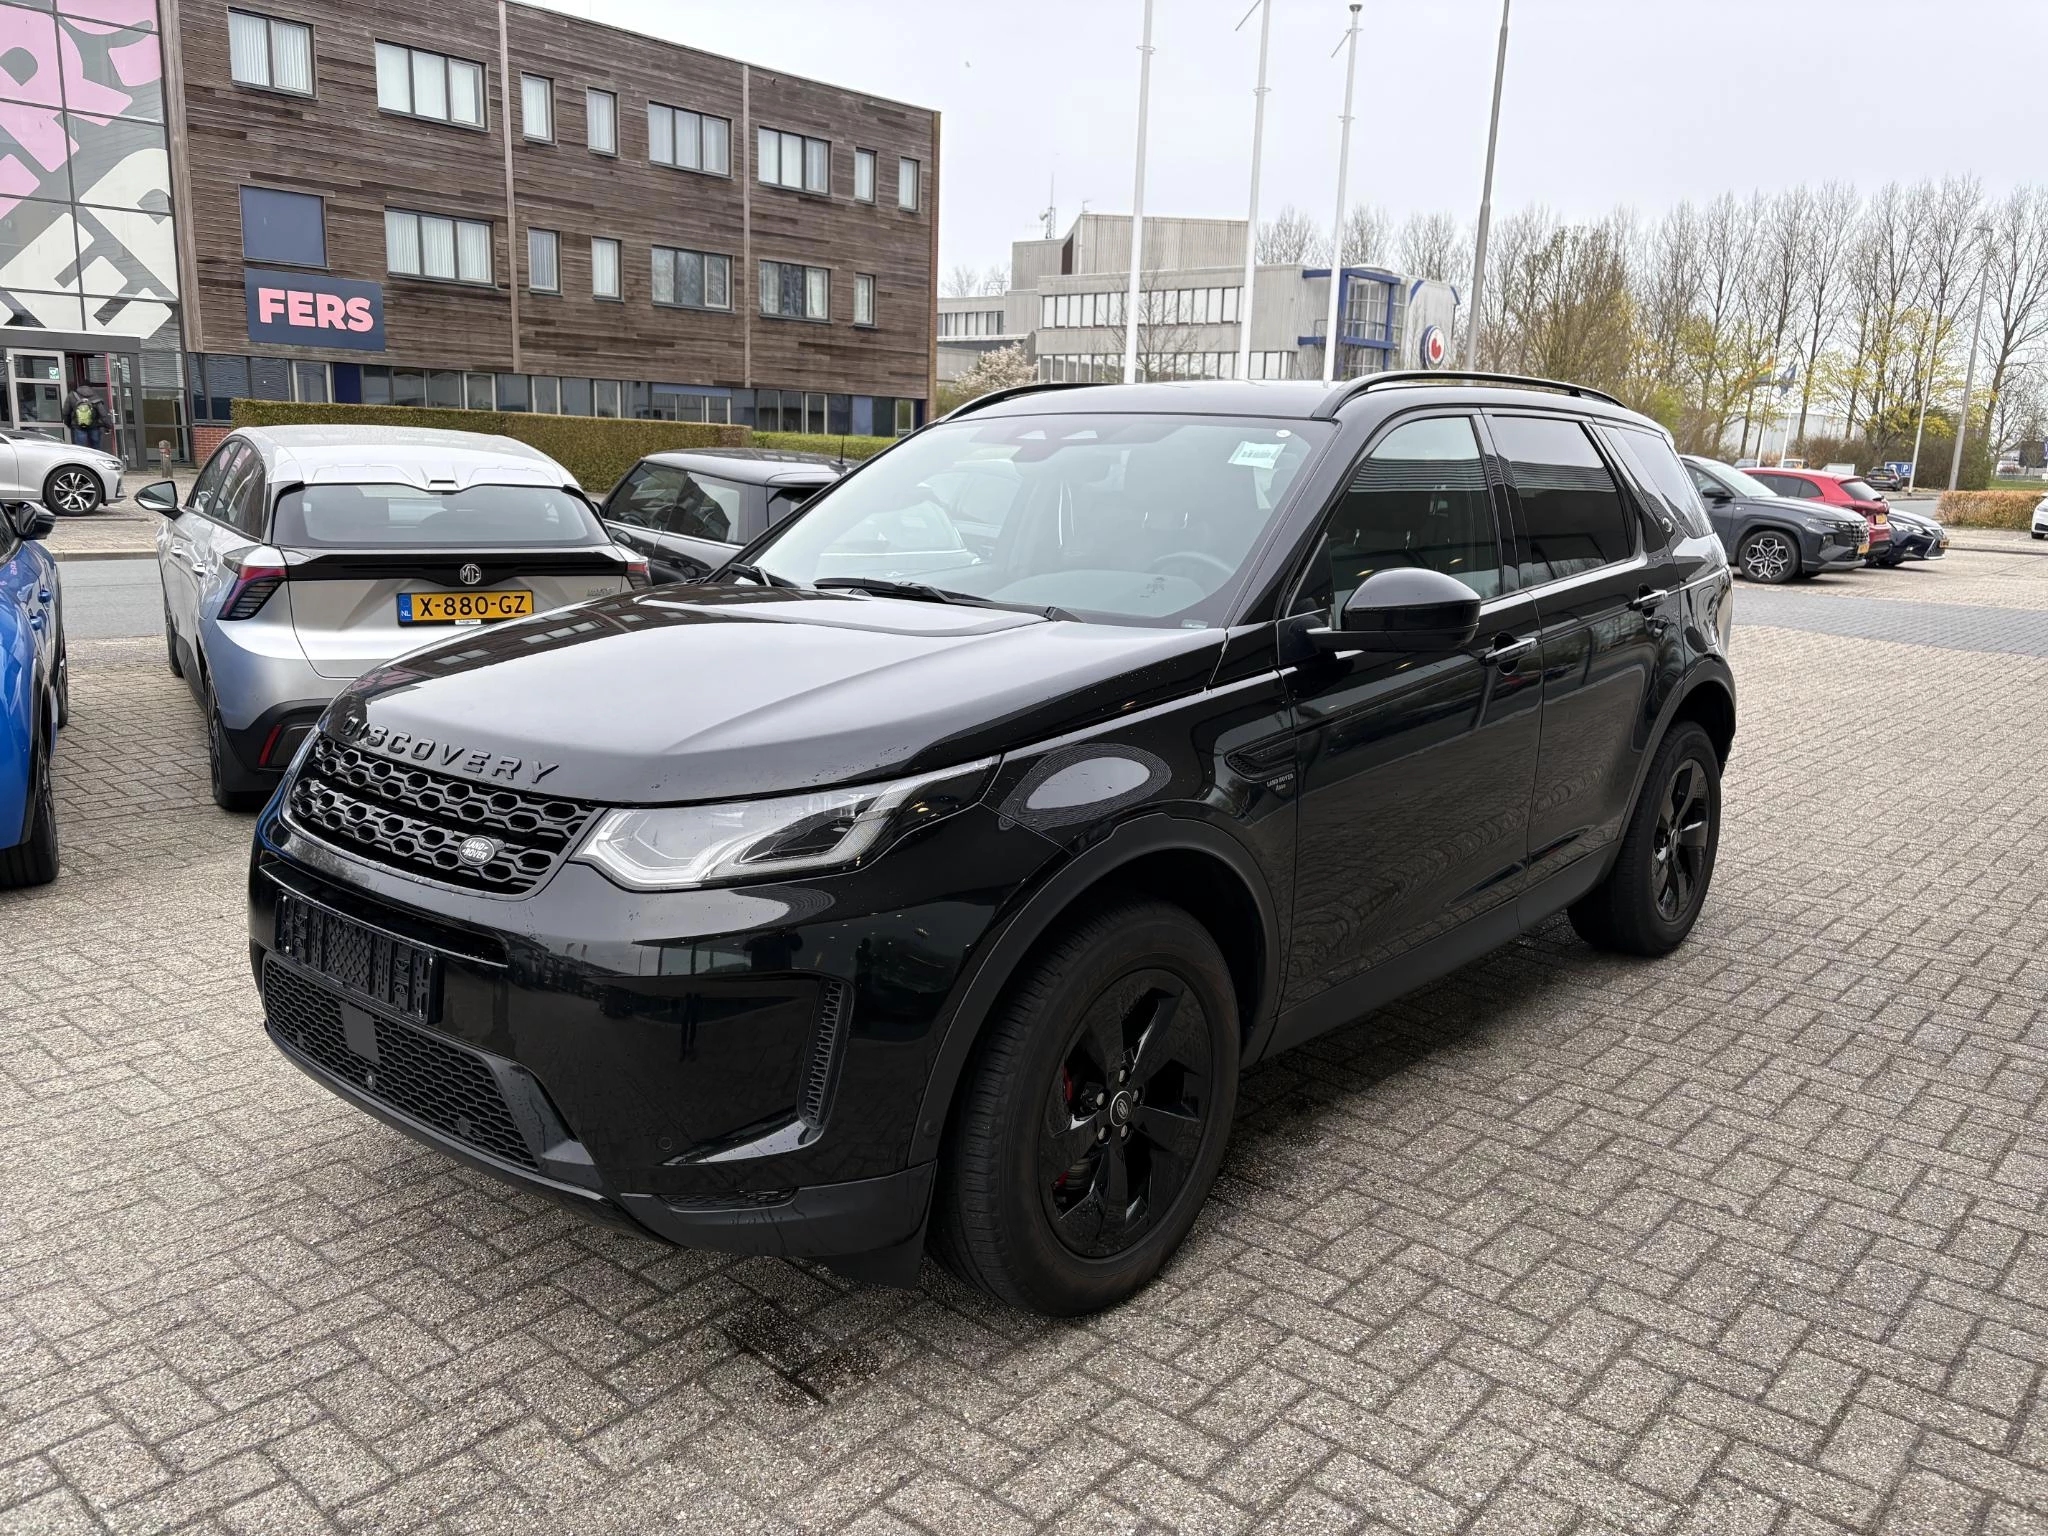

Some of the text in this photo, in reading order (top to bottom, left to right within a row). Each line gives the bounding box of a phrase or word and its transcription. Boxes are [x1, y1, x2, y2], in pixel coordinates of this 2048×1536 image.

[258, 287, 374, 332] FERS
[460, 564, 481, 584] MG
[400, 609, 412, 617] NL
[419, 595, 526, 617] X-880-GZ
[341, 716, 560, 784] DISCOVERY
[464, 848, 488, 860] ROVER
[466, 840, 486, 850] LAND
